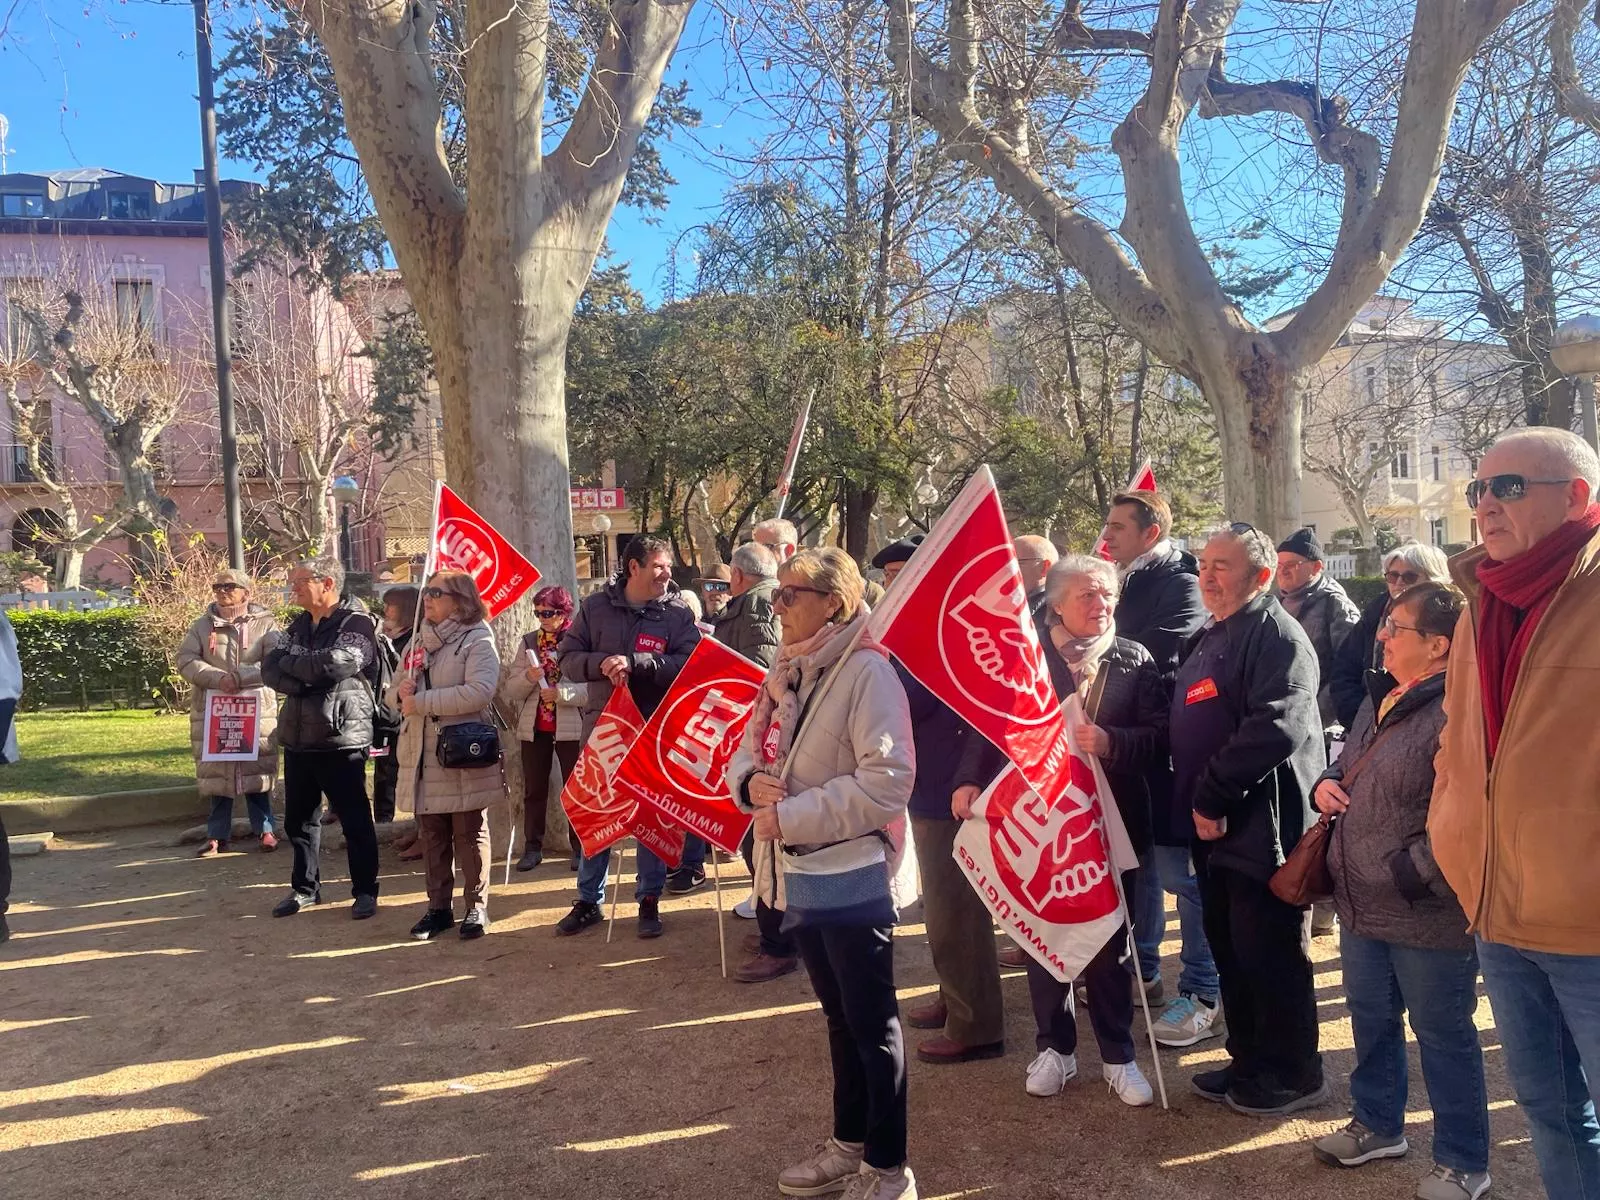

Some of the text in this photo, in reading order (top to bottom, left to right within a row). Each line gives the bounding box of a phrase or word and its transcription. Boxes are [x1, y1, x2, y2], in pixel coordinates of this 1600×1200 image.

[441, 523, 494, 581] UGT
[489, 572, 524, 607] .ugt.es
[639, 638, 656, 648] UGT
[212, 703, 256, 717] CALLE
[667, 688, 754, 785] UGT
[958, 845, 1066, 974] www.UGT.es
